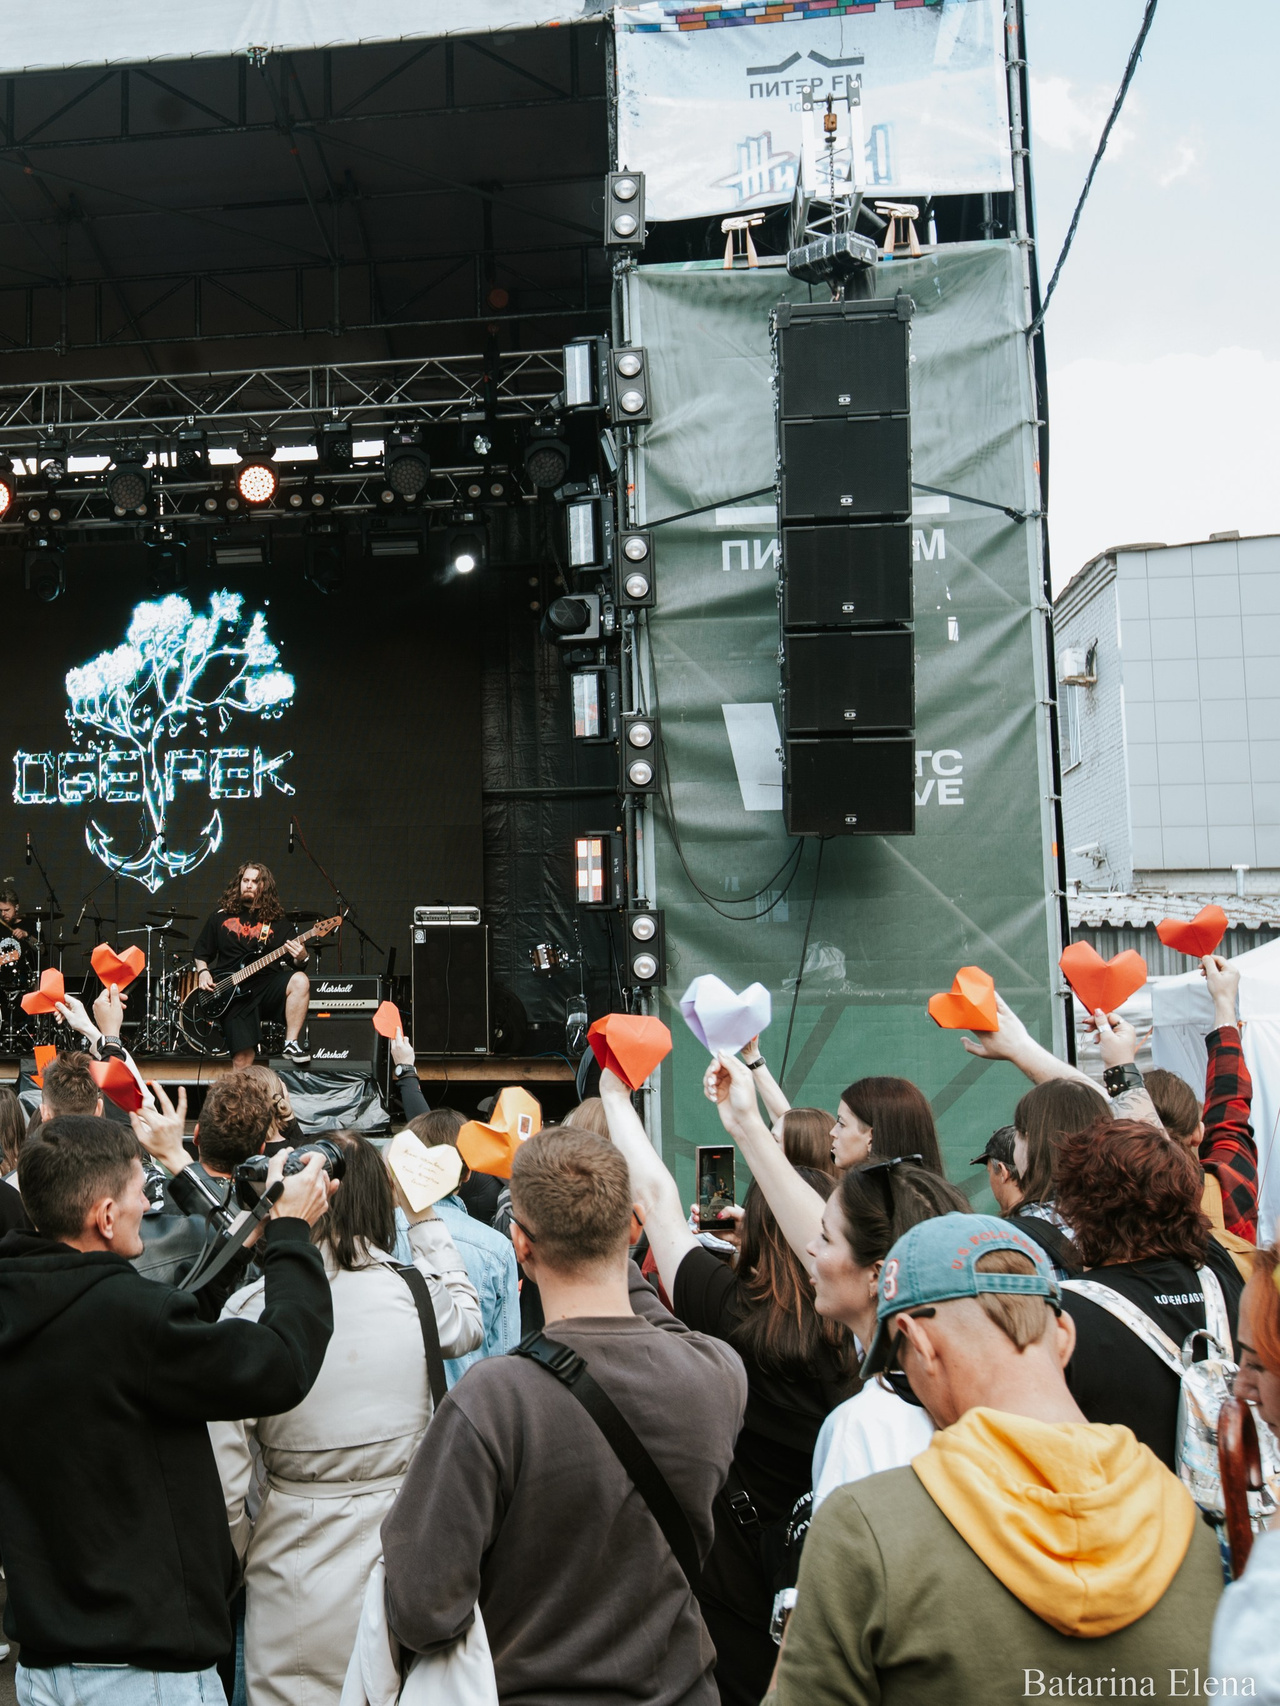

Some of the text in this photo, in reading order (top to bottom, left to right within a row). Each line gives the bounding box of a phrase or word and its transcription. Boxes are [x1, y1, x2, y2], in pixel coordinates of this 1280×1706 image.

[914, 528, 946, 562] M
[914, 748, 964, 777] ТС
[914, 778, 965, 806] VE
[316, 982, 354, 993] Marshall
[312, 1048, 350, 1060] Marshall
[969, 1230, 1010, 1246] POLO
[883, 1257, 900, 1301] 3
